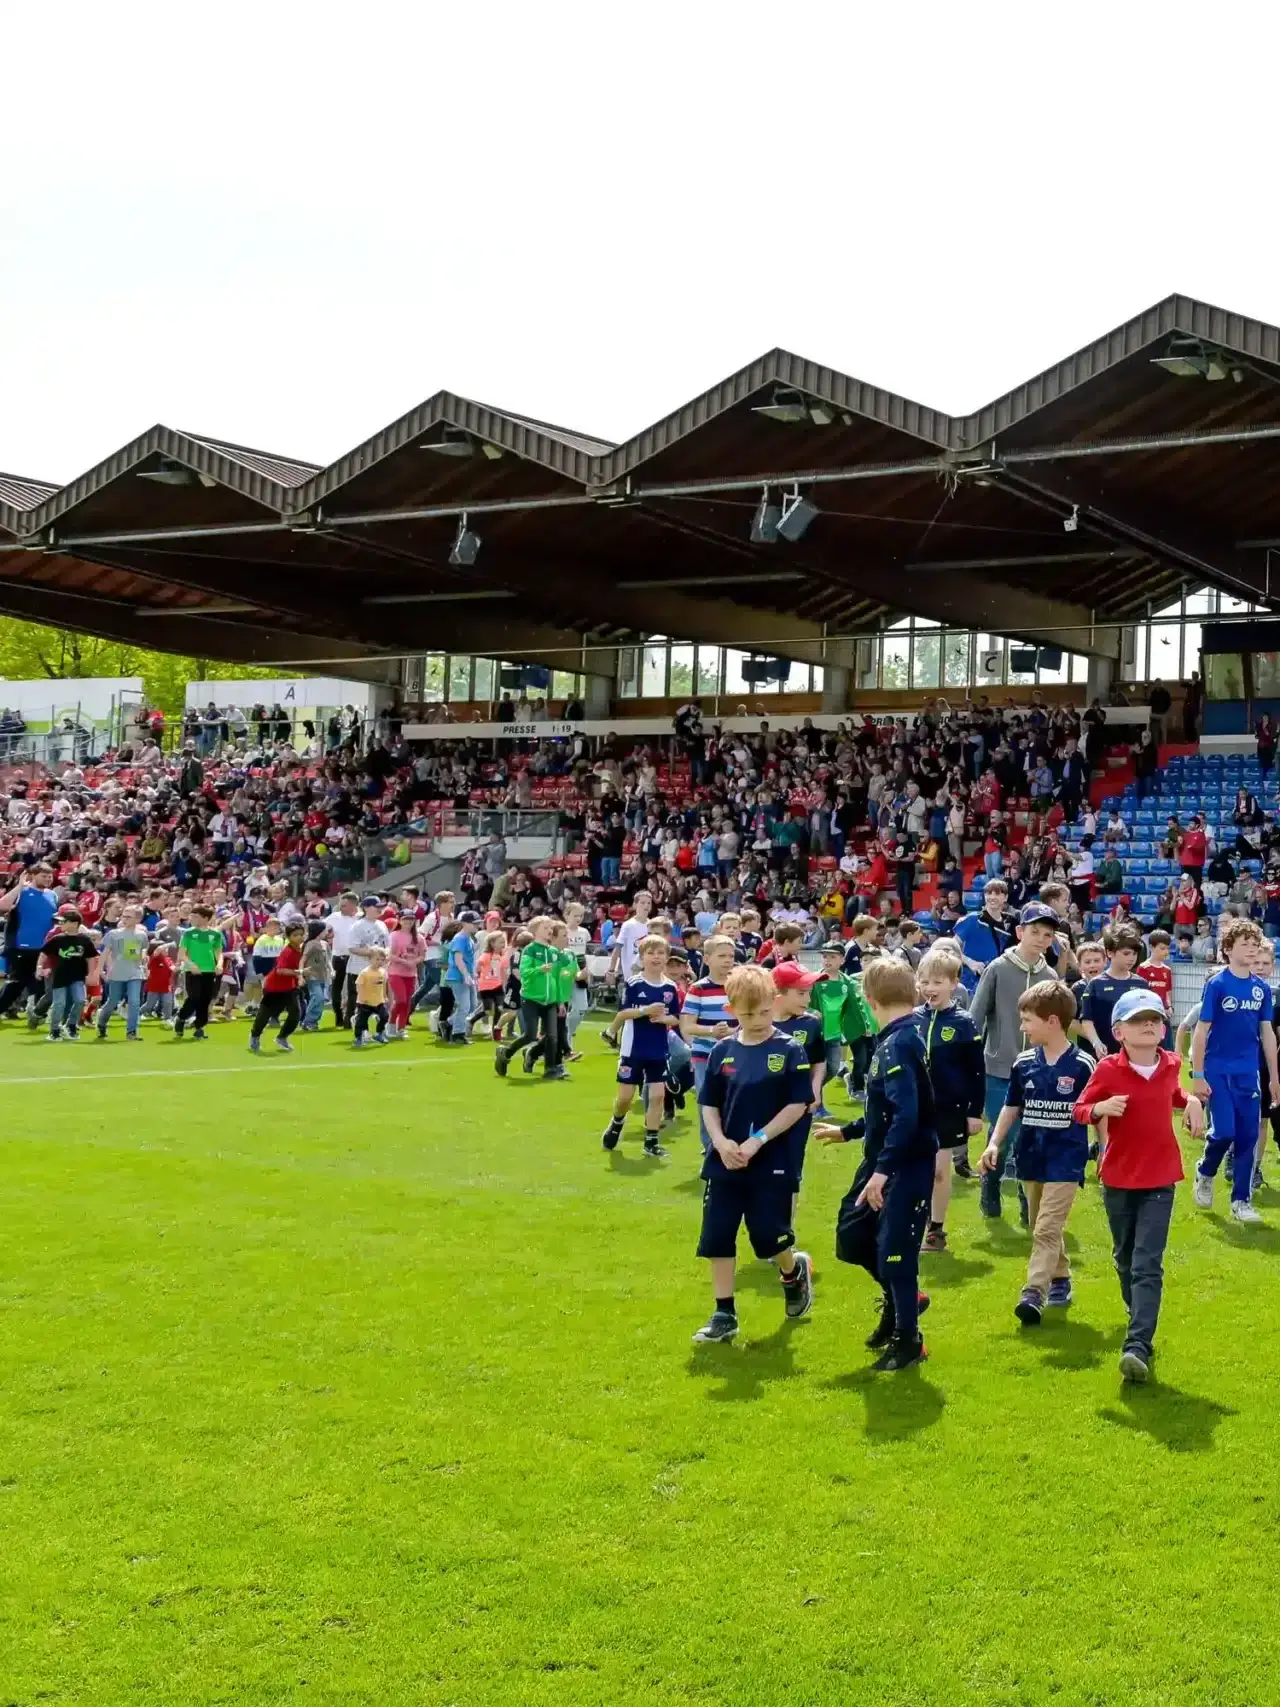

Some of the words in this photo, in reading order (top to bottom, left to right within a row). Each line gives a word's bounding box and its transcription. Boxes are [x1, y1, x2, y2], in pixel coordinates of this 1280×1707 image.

[985, 655, 997, 672] C
[284, 686, 296, 700] A
[502, 725, 536, 734] PRESSE
[1240, 1000, 1262, 1010] JAKO
